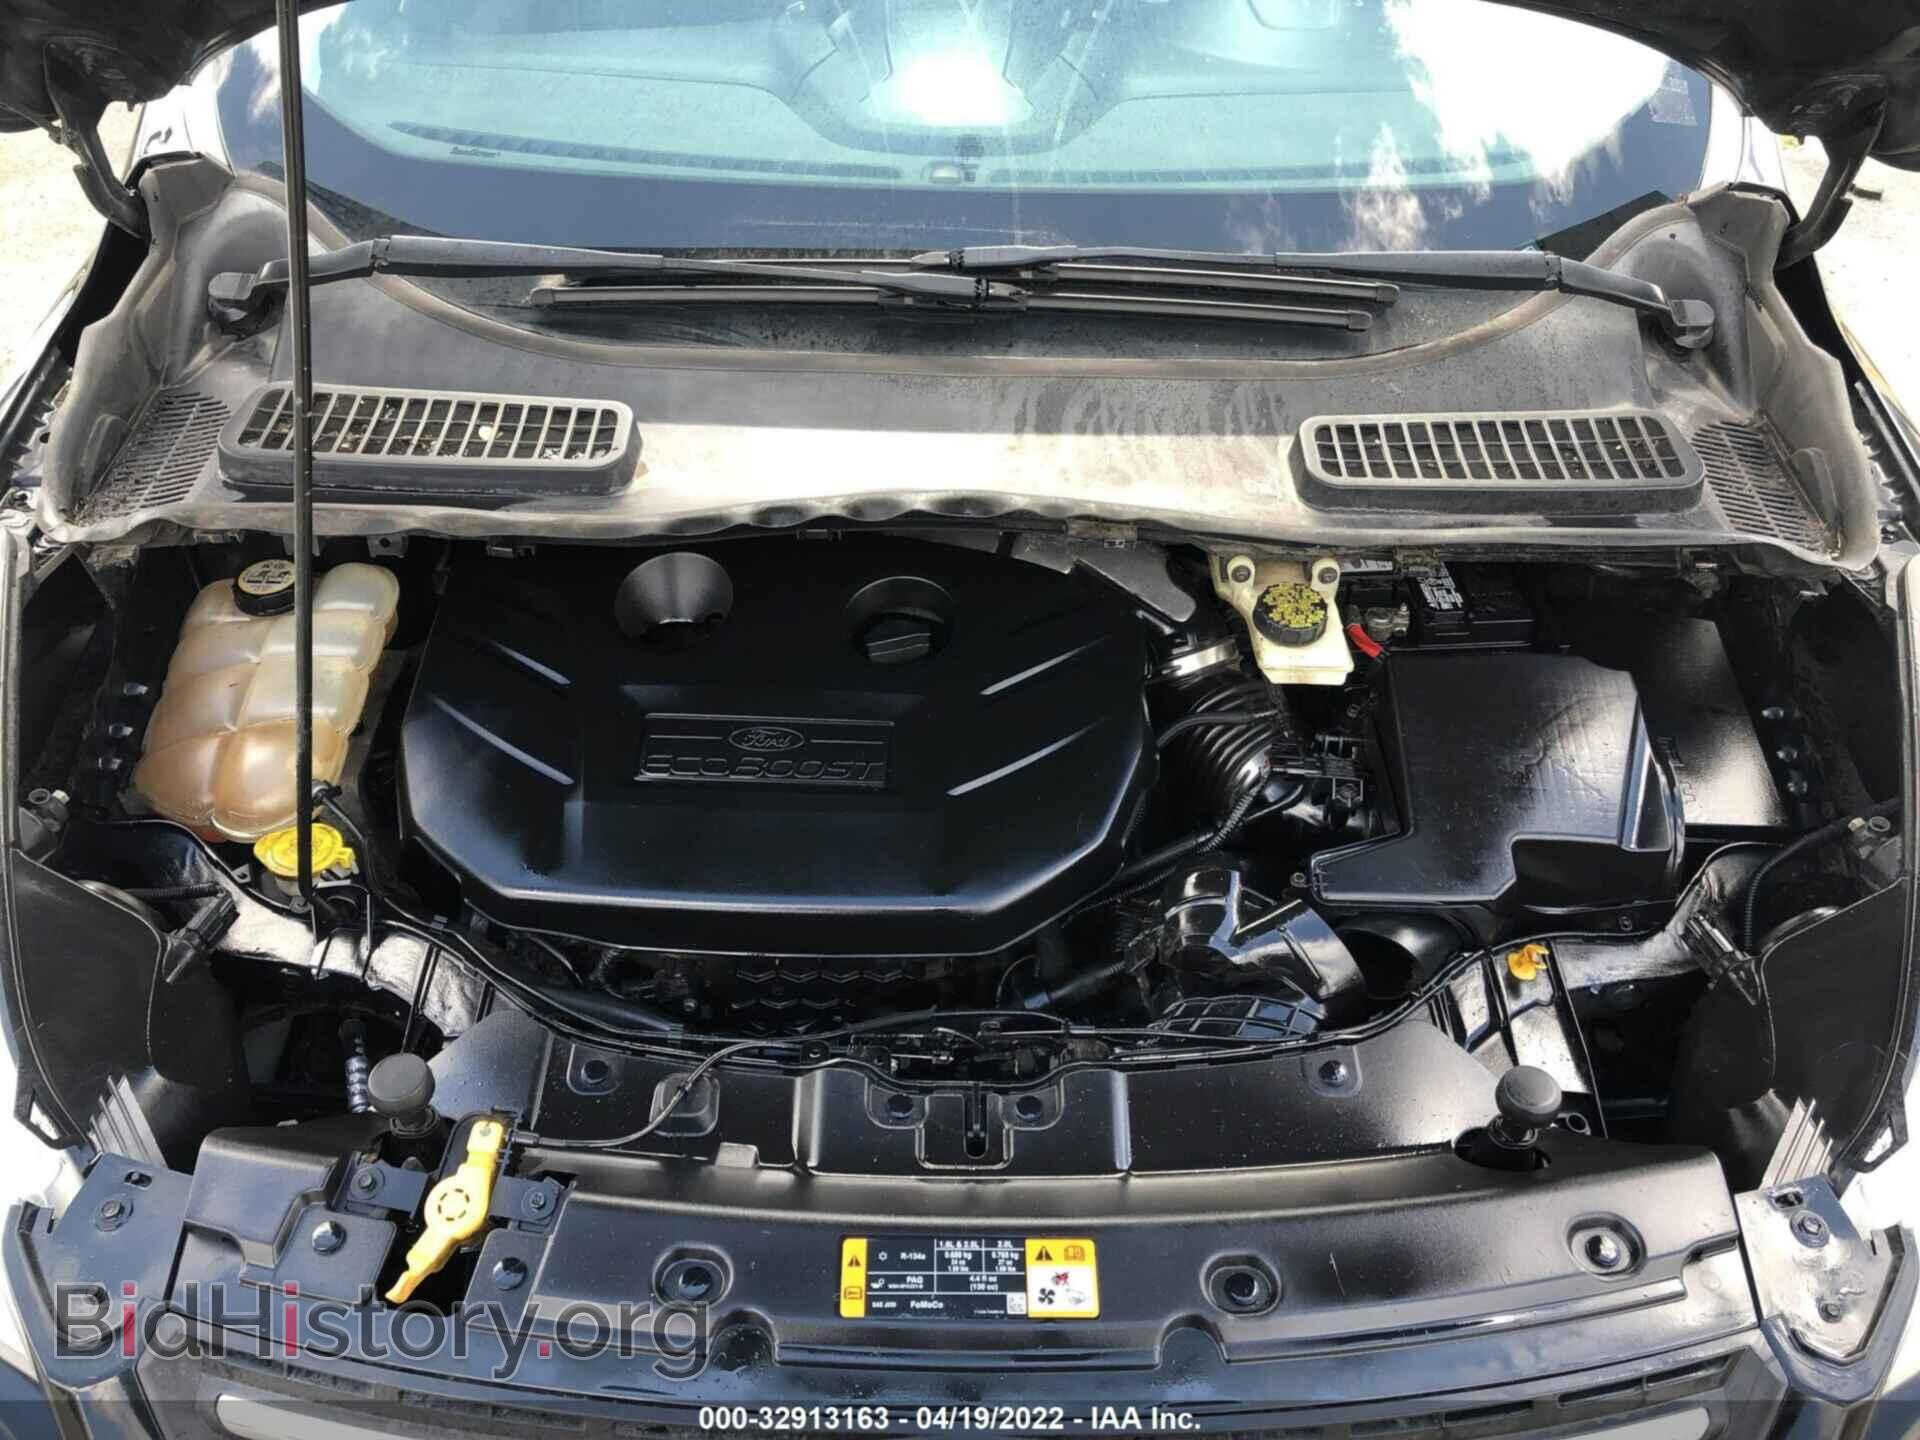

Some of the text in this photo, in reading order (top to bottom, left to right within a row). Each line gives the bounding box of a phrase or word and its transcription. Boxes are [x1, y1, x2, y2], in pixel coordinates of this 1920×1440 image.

[742, 728, 792, 748] Ford
[906, 1275, 923, 1284] PAG
[909, 1300, 944, 1309] FoMoCo
